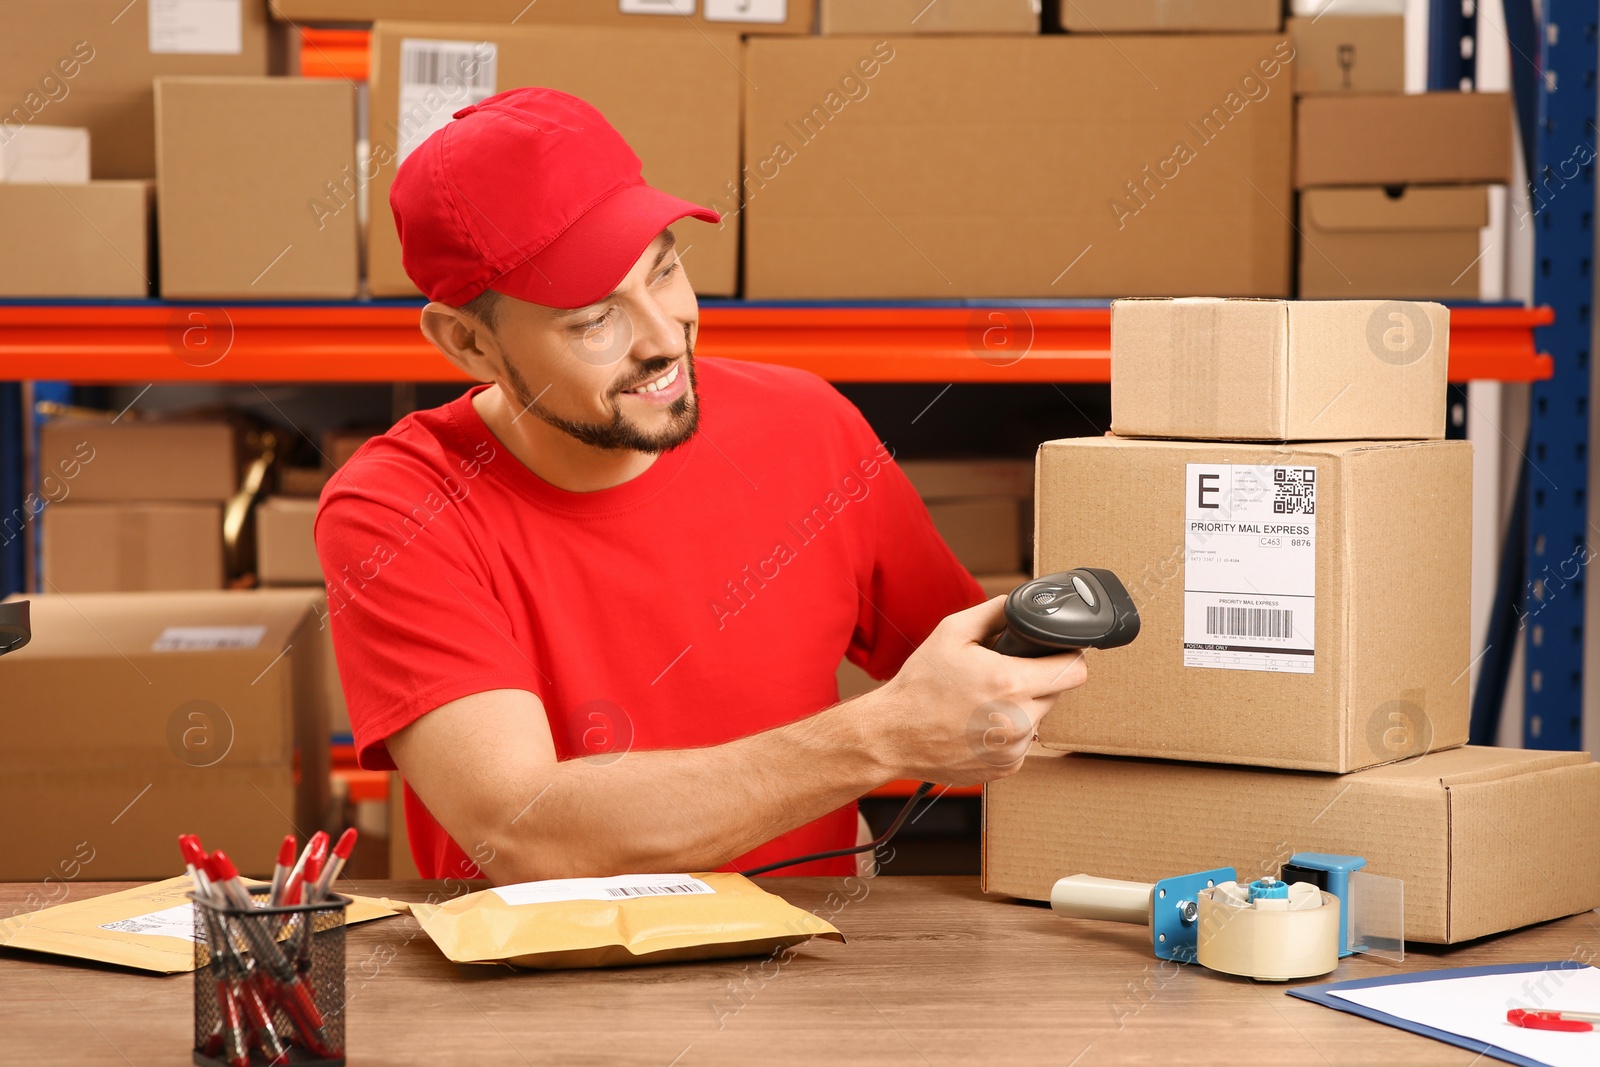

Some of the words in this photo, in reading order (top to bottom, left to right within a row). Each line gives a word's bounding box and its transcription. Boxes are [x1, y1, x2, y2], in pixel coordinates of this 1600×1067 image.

[1198, 474, 1220, 509] E
[1191, 522, 1236, 533] PRIORITY
[1238, 524, 1261, 534] MAIL
[1263, 525, 1310, 535] EXPRESS
[1260, 538, 1281, 546] C463
[1291, 539, 1311, 547] 0876
